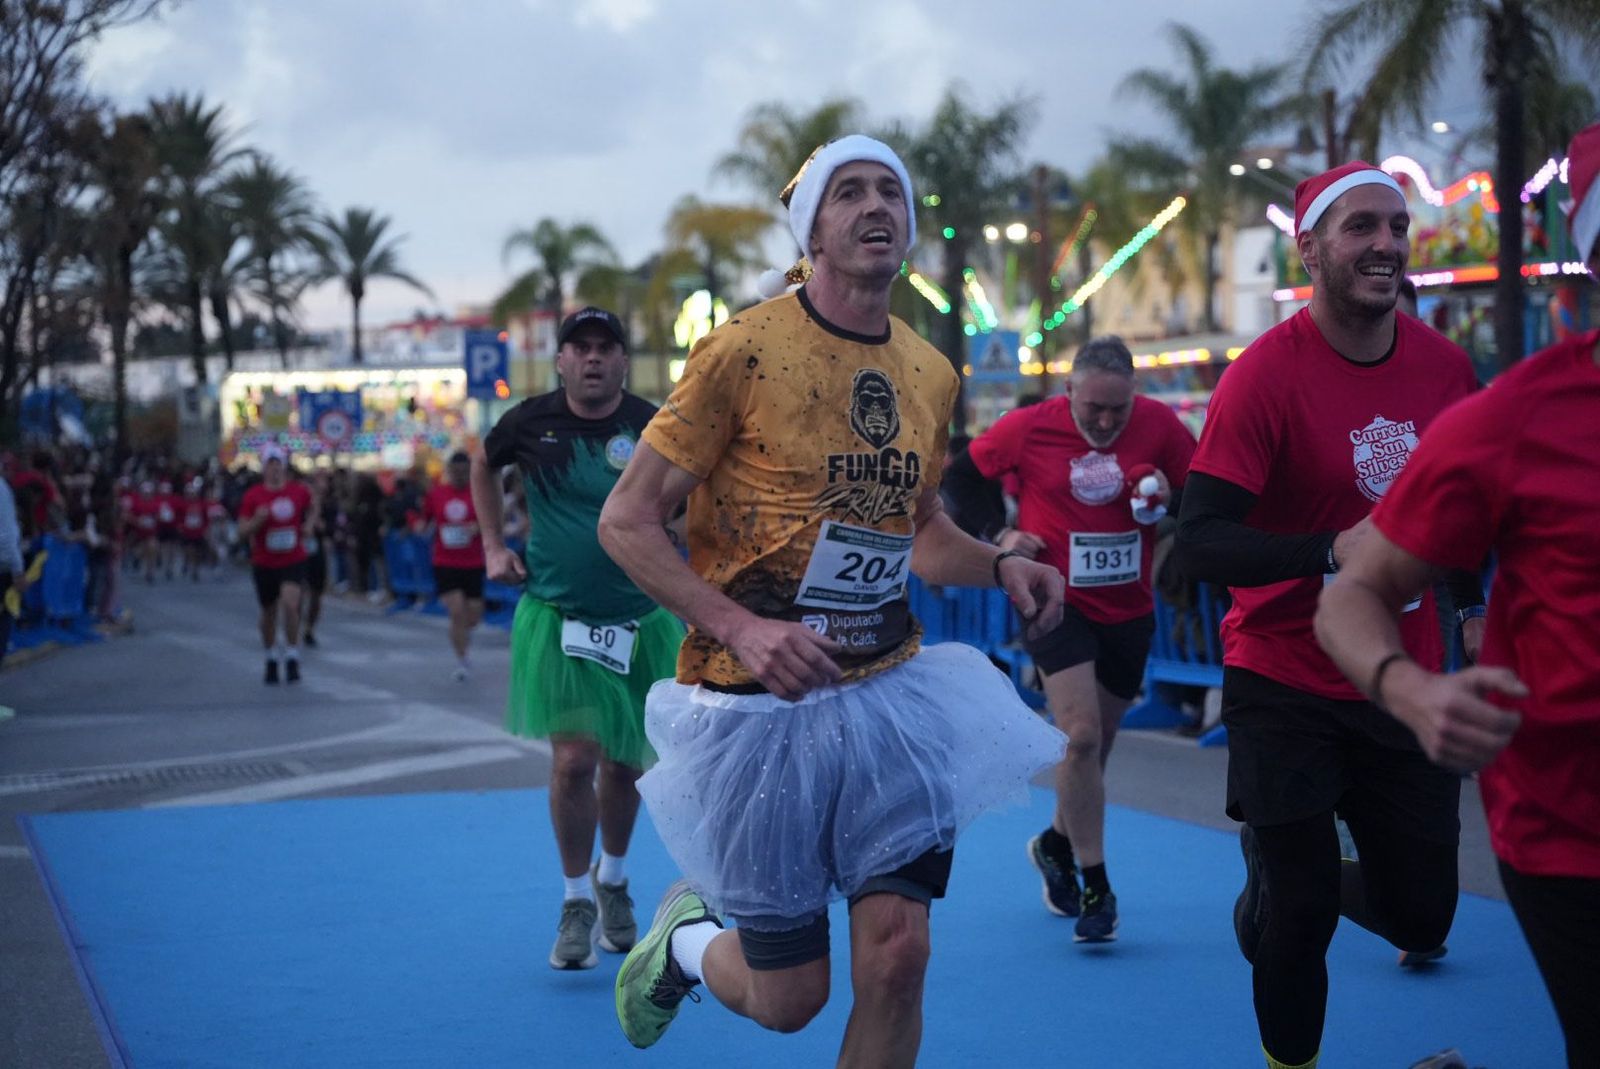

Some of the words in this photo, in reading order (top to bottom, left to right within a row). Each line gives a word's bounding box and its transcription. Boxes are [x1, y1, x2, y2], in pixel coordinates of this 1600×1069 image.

[473, 346, 499, 381] P
[1350, 420, 1416, 445] Carrera
[1371, 439, 1407, 458] San
[827, 447, 920, 489] FUNGO
[835, 551, 906, 584] 204
[1082, 548, 1133, 569] 1931
[854, 583, 879, 591] DAVID
[830, 613, 884, 629] Diputación
[589, 624, 616, 648] 60
